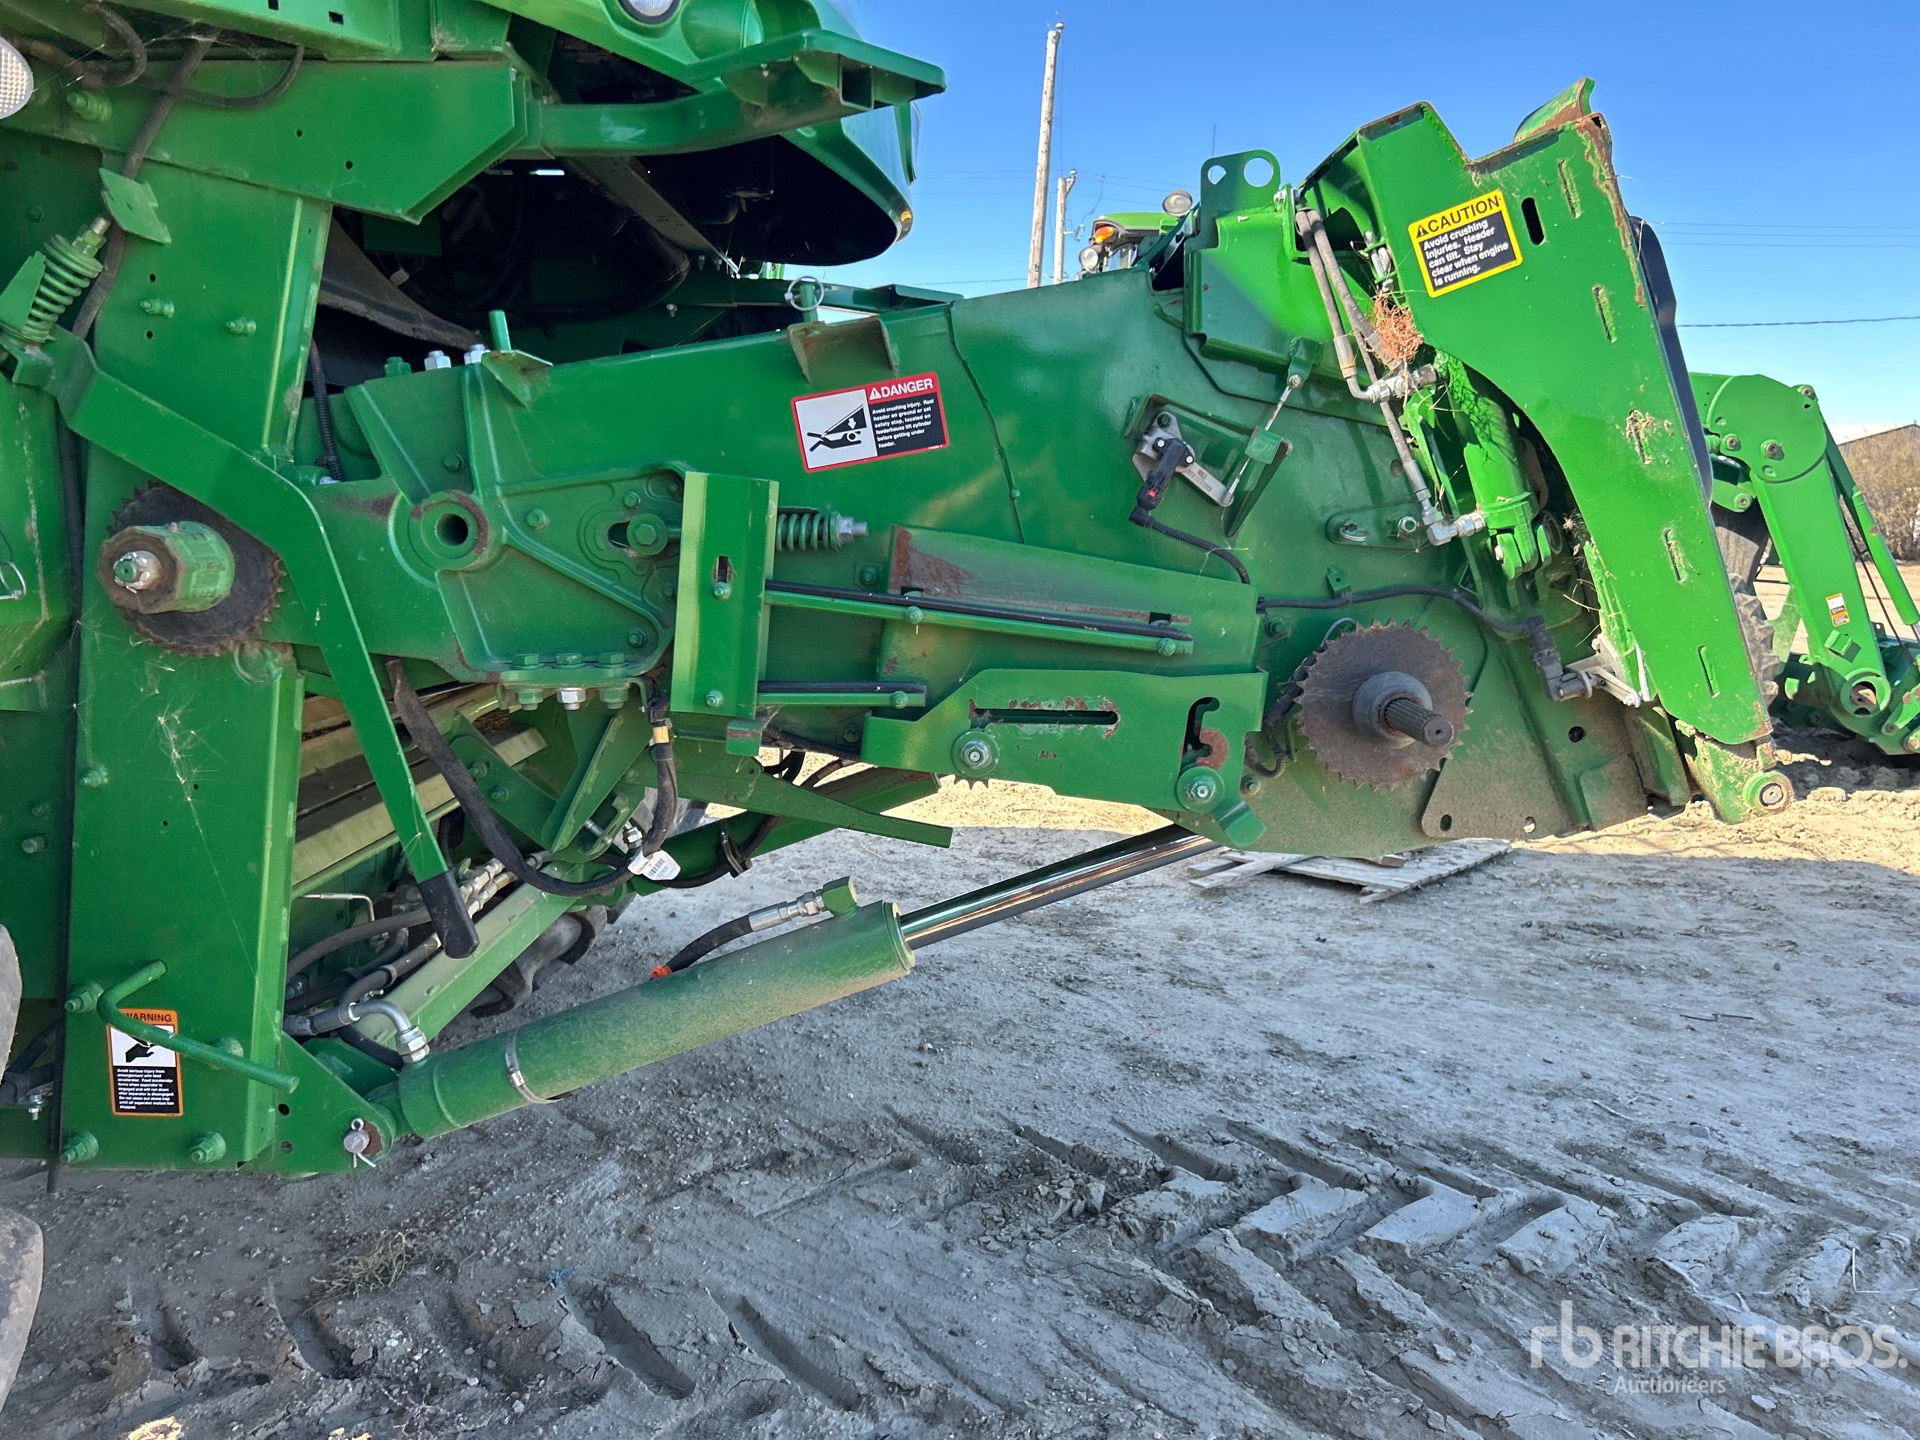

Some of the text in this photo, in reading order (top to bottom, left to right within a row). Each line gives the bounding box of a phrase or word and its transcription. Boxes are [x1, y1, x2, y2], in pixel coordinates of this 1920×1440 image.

[1428, 196, 1499, 232] CAUTION
[1424, 220, 1488, 250] Avoid crushing
[1464, 227, 1495, 244] Header
[1429, 242, 1483, 268] can tilt. Stay
[1432, 242, 1508, 277] clear when engine
[1445, 264, 1481, 283] running.
[881, 378, 933, 398] DANGER
